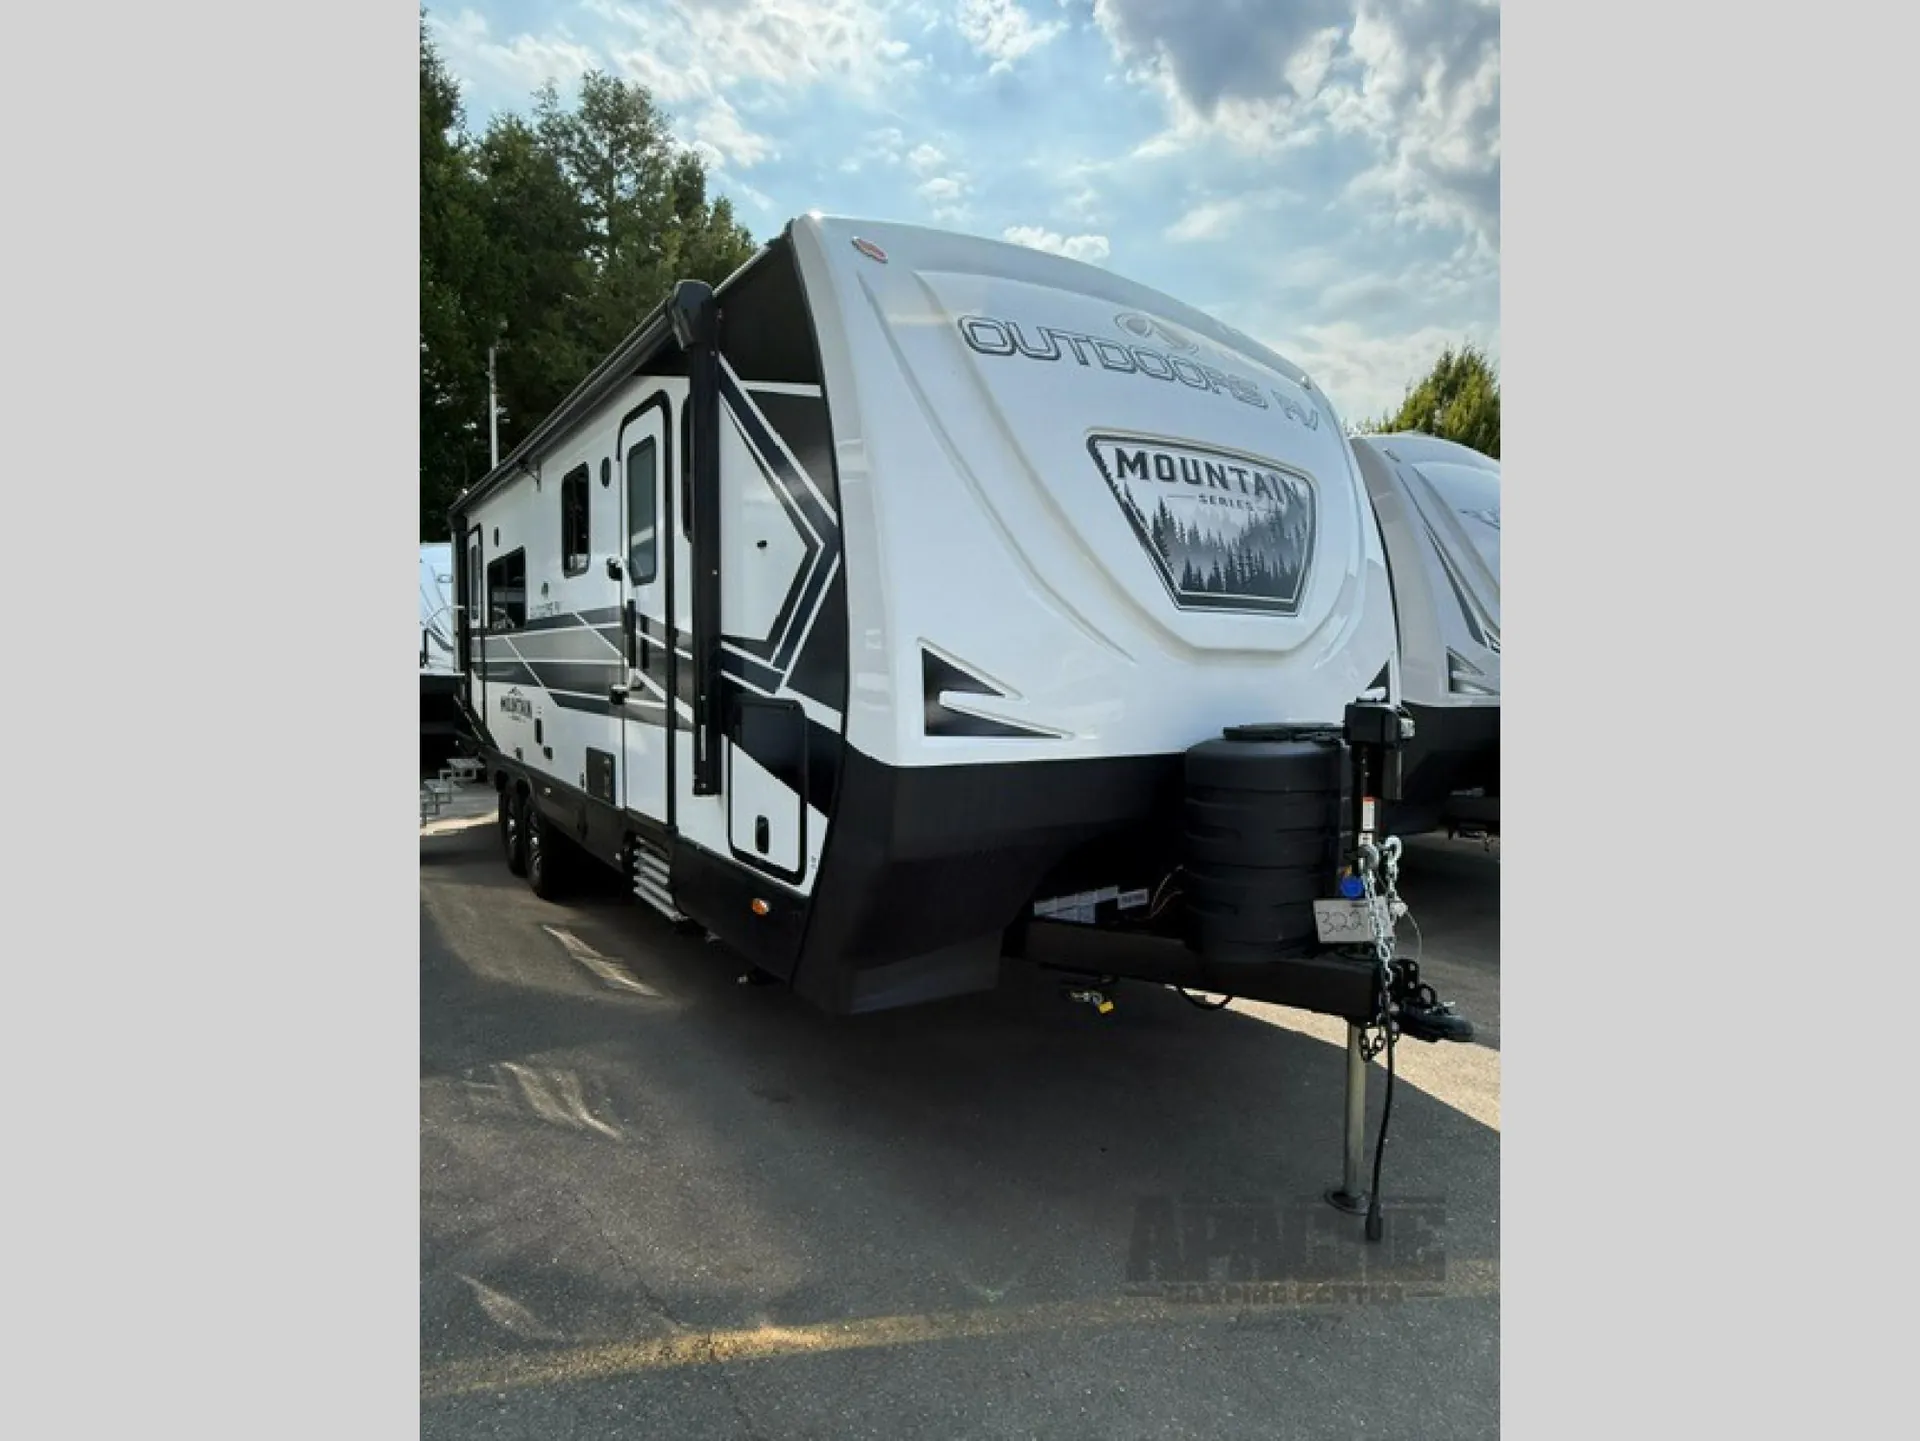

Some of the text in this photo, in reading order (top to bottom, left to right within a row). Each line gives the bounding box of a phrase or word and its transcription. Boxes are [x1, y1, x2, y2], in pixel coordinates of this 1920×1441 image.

[958, 315, 1269, 410] OUTDOORS
[1114, 447, 1300, 505] MOUNTAIN
[1198, 493, 1254, 512] SERIES
